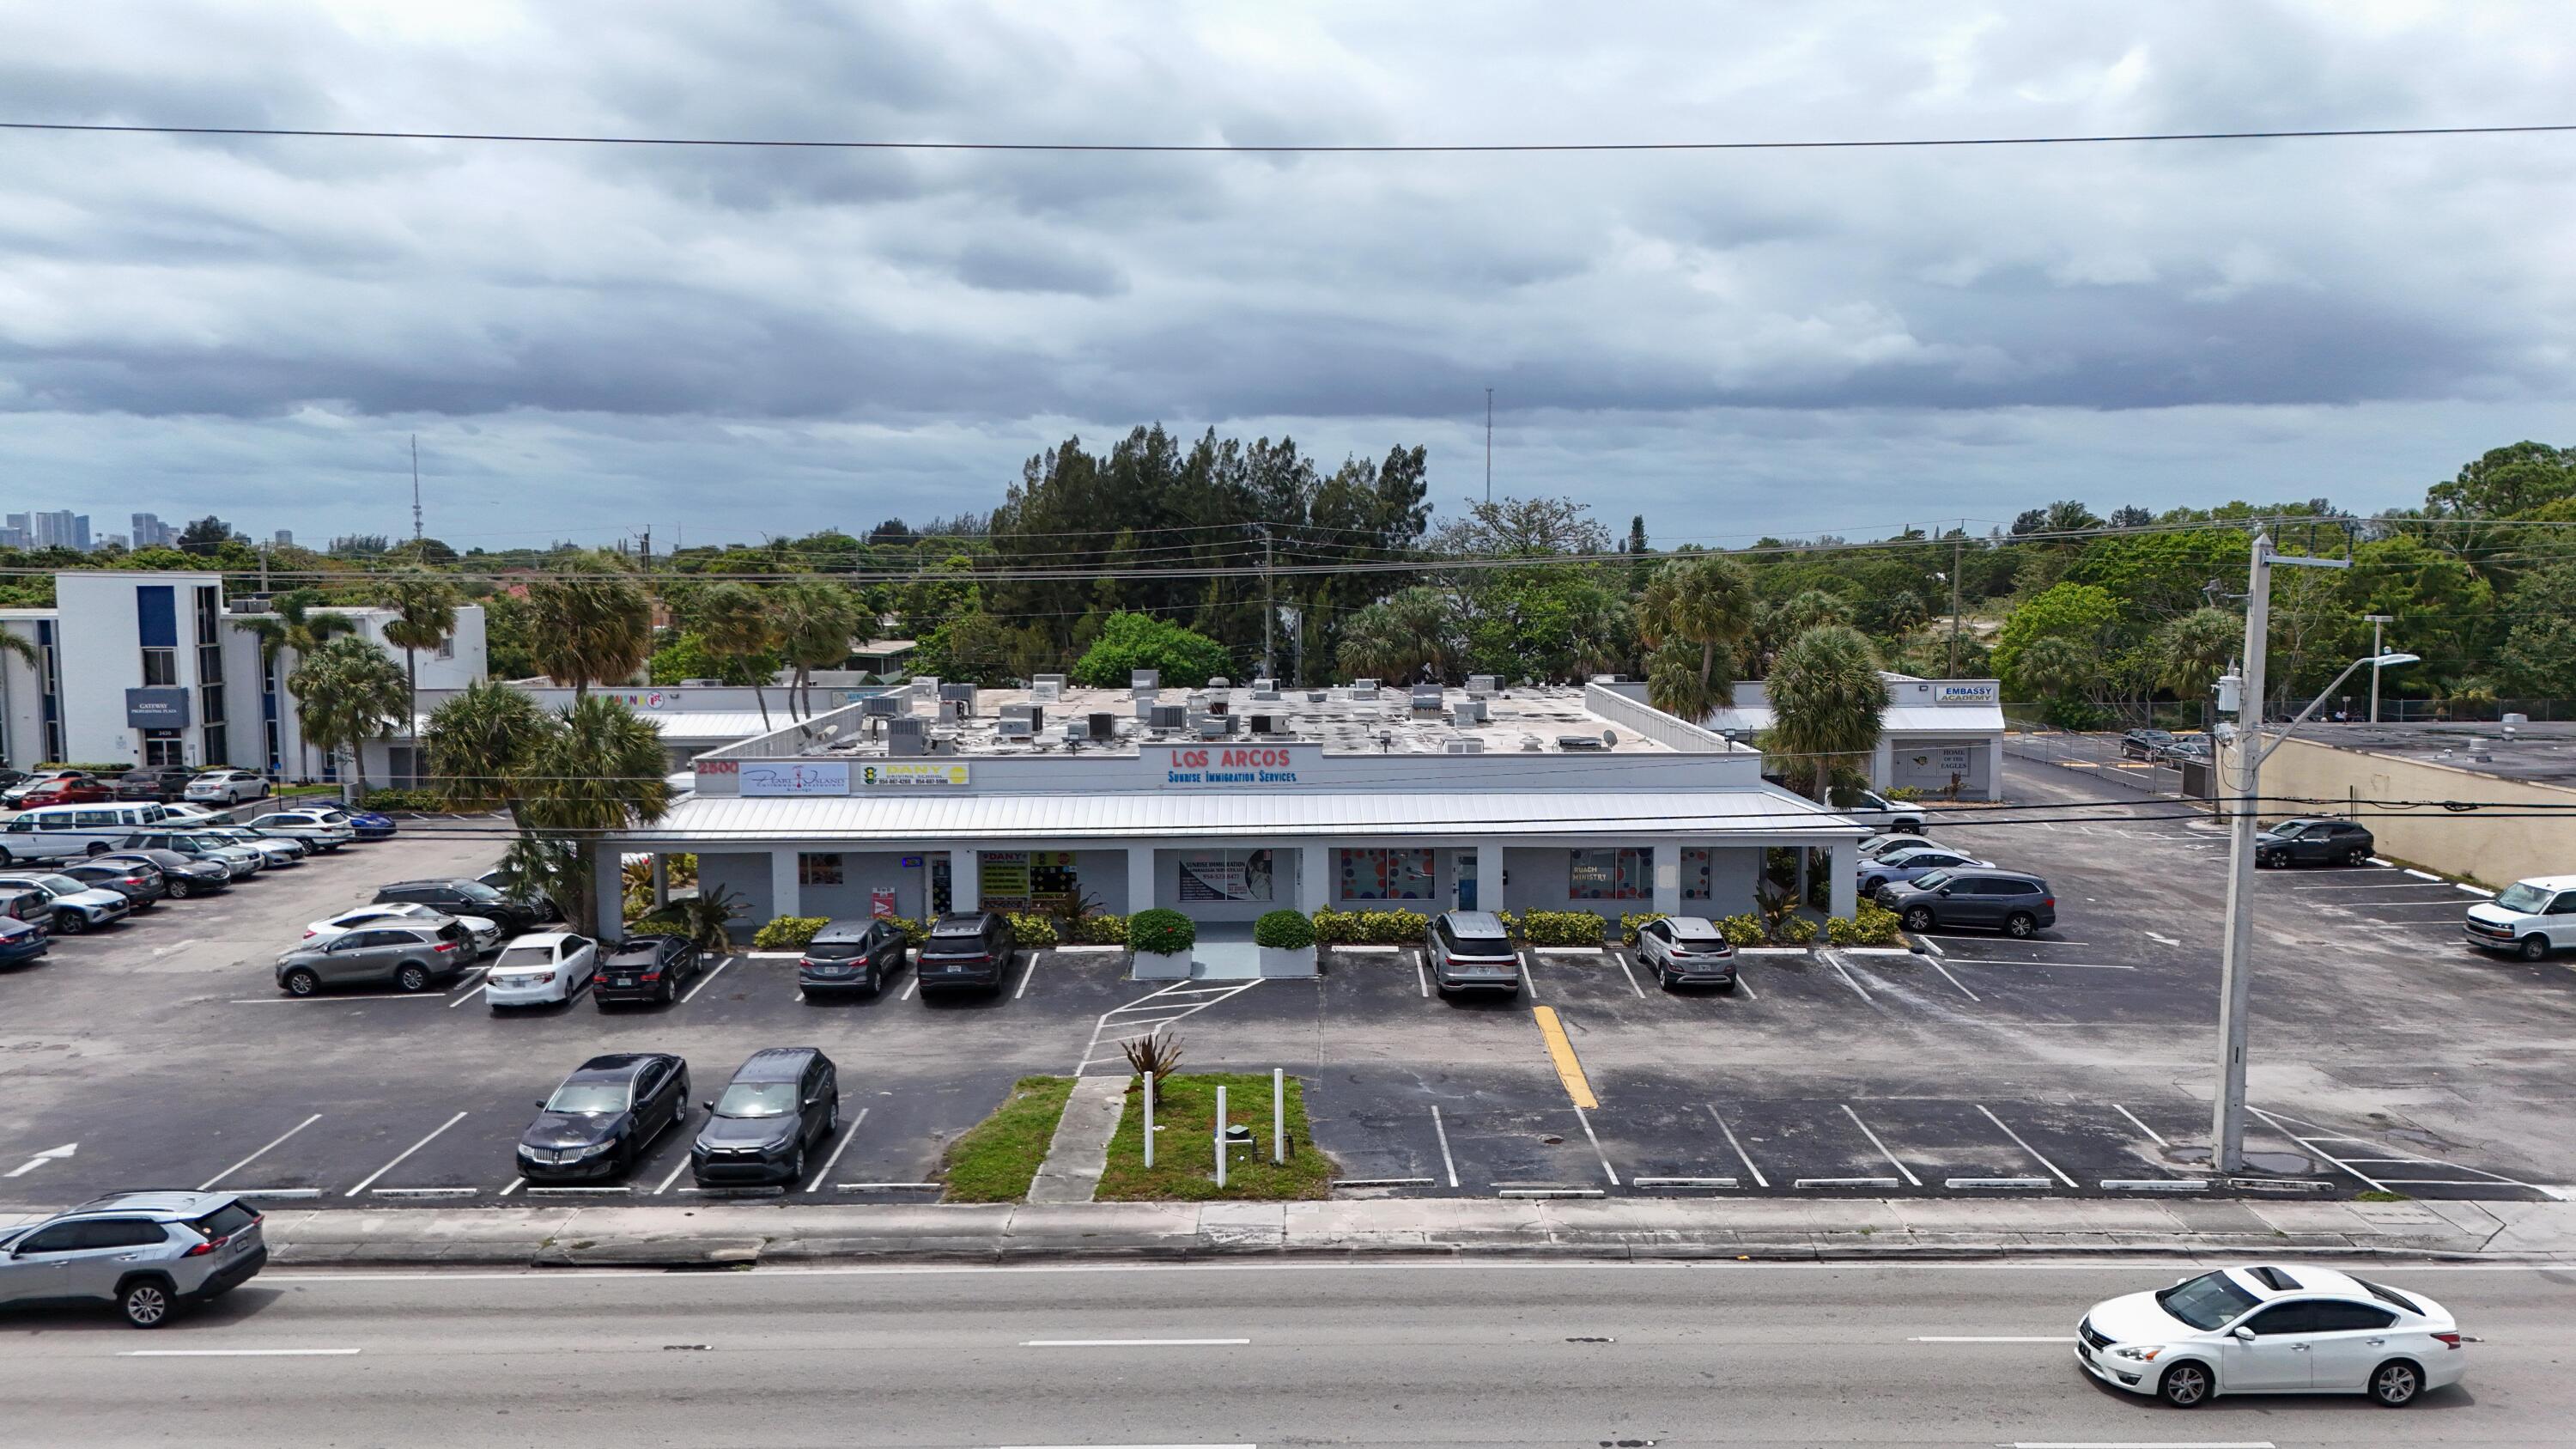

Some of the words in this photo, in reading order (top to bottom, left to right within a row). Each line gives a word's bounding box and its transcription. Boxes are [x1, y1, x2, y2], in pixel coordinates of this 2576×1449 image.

[1172, 750, 1209, 768] LOS
[1221, 749, 1291, 767] ARCOS
[697, 761, 739, 775] 2500
[886, 765, 943, 774] DANY
